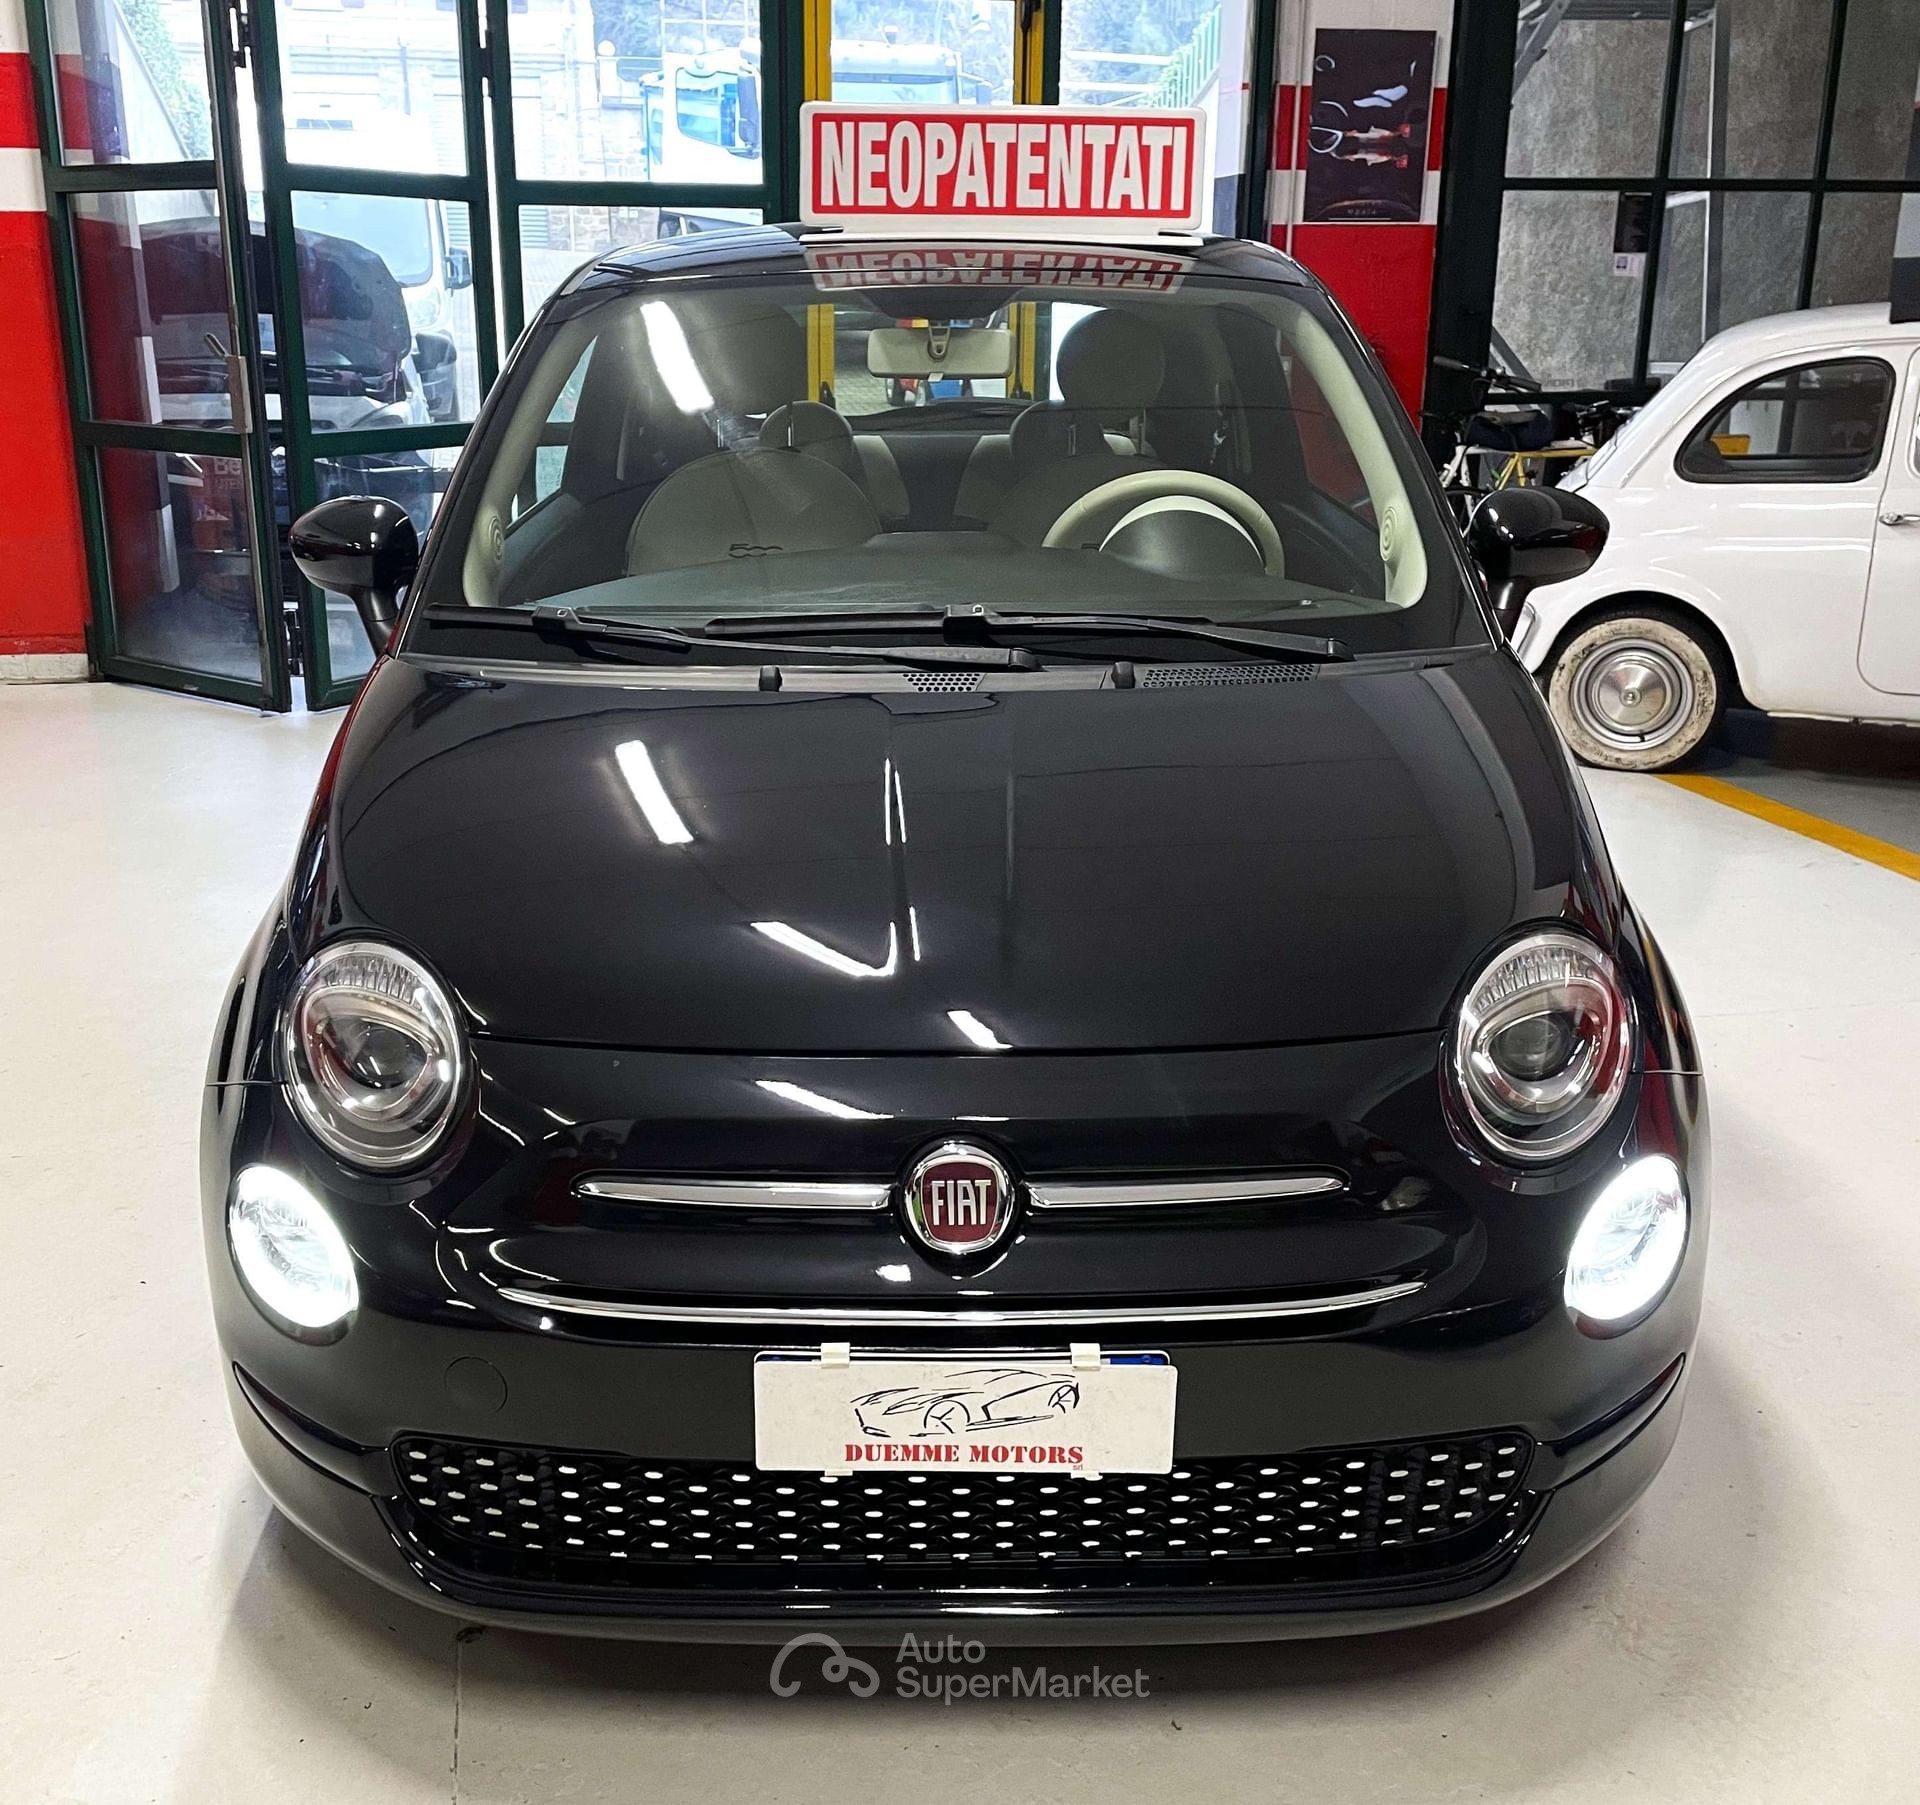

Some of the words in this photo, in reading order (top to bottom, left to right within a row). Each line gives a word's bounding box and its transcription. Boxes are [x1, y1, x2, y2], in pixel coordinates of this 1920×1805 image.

[820, 120, 1188, 211] NEOPATENTATI
[931, 1179, 992, 1226] FIAT
[844, 1444, 960, 1462] DUEMME
[968, 1445, 1083, 1464] MOTORS
